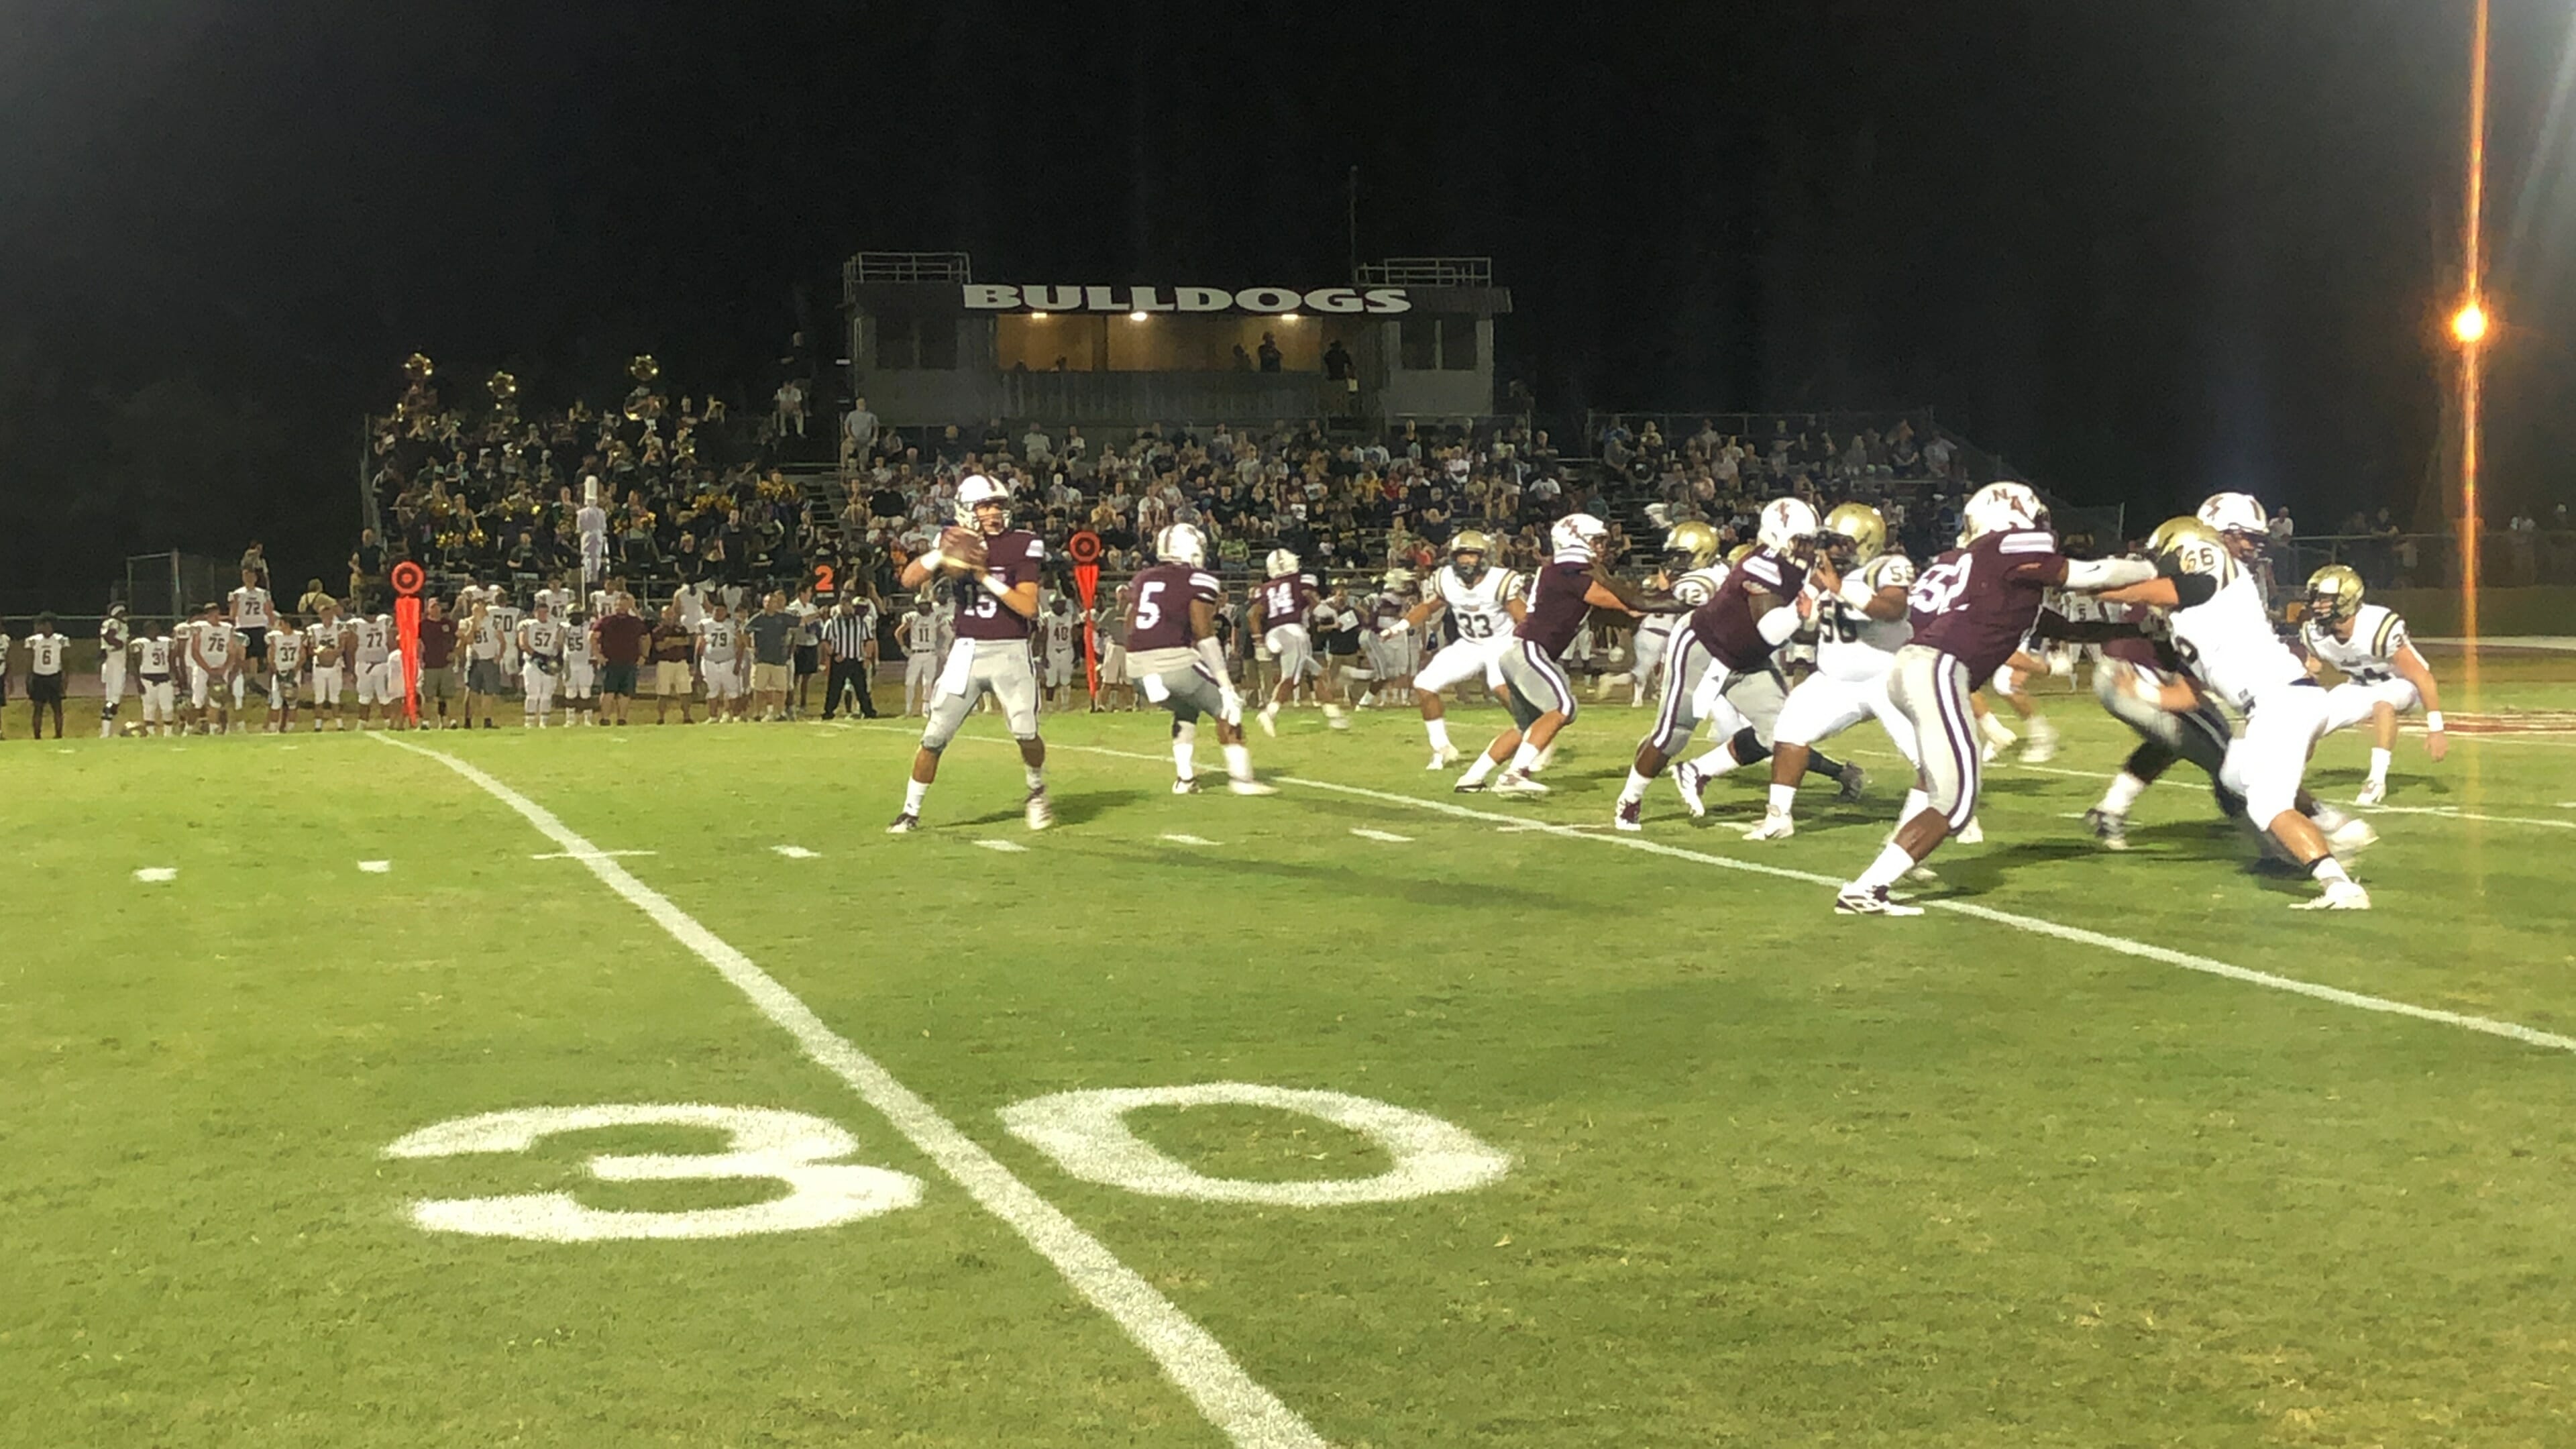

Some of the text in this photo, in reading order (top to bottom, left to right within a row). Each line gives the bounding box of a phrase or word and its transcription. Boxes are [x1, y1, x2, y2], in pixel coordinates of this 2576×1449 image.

[962, 284, 1411, 313] BULLDOGS
[815, 565, 834, 590] 2
[245, 601, 260, 616] 72
[964, 584, 997, 618] 15
[1135, 581, 1166, 629] 5
[1267, 582, 1295, 619] 14
[1458, 613, 1494, 638] 33
[366, 632, 382, 648] 77
[535, 632, 551, 647] 57
[711, 633, 727, 647] 79
[42, 649, 52, 665] 6
[152, 651, 166, 666] 31
[280, 646, 297, 662] 37
[380, 1081, 1513, 1242] 30
